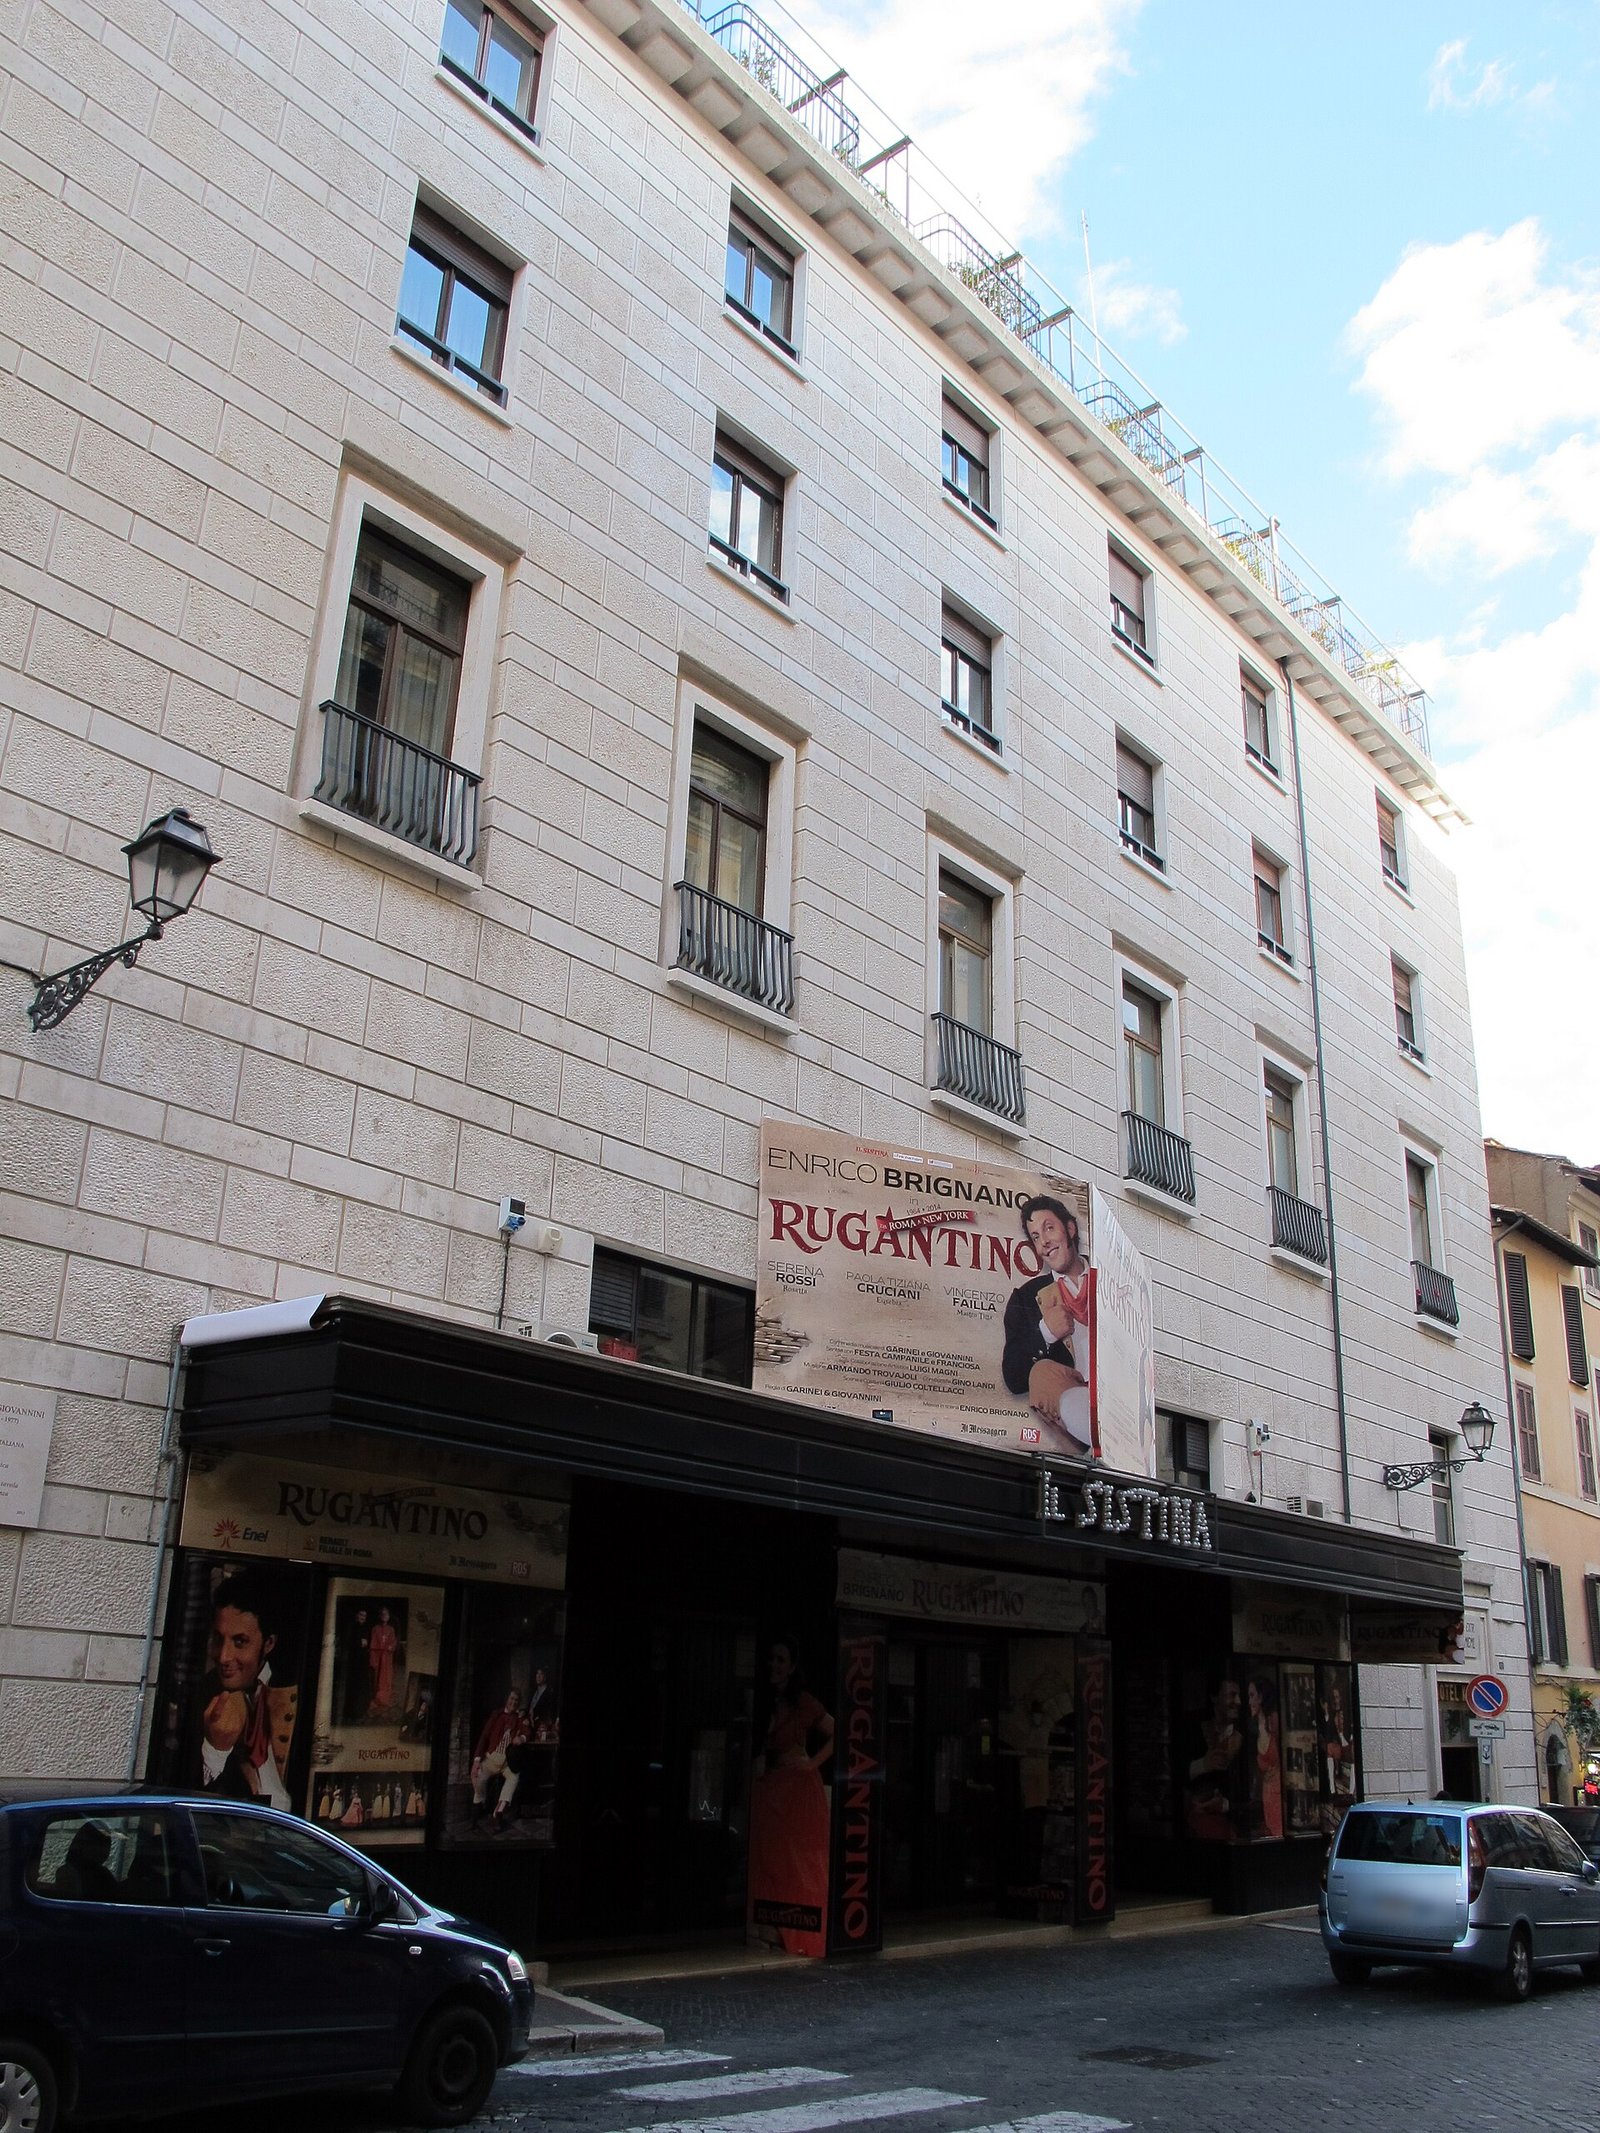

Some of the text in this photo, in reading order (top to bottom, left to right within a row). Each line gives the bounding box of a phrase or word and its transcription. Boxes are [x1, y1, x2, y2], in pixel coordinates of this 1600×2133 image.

[768, 1147, 1032, 1210] ENRICO BRIGNANO
[926, 1203, 941, 1212] 2014
[889, 1220, 916, 1231] ROMA
[922, 1213, 942, 1225] NEW
[944, 1211, 969, 1221] YORK
[768, 1198, 1043, 1281] RUGANTINO
[767, 1260, 825, 1278] SERENA
[776, 1272, 816, 1287] ROSSI
[846, 1271, 931, 1291] PAOLA TIZIANA
[857, 1282, 920, 1301] CRUCIANI
[943, 1285, 1005, 1304] VINCENZO
[952, 1297, 997, 1312] FAILLA
[854, 1348, 880, 1358] FESTA
[881, 1352, 929, 1365] CAMPANILE
[936, 1359, 980, 1371] FRANCIOSA
[886, 1345, 920, 1356] GARINEI
[926, 1350, 973, 1362] GIOVANNINI
[826, 1363, 871, 1375] ARMANDO
[872, 1368, 917, 1381] TROVAJOLI
[952, 1378, 971, 1387] GINO
[972, 1381, 996, 1391] LANDI
[909, 1365, 959, 1377] LUIGI MAGNI
[786, 1385, 823, 1396] GARINEI
[831, 1390, 882, 1403] GIOVANNINI
[884, 1379, 912, 1390] GIULIO
[913, 1383, 965, 1396] COLTELLACCI
[959, 1404, 988, 1415] ENRICO
[989, 1407, 1030, 1419] BRIGNANO
[969, 1424, 1008, 1437] Messaggero
[1022, 1428, 1037, 1441] RDS
[275, 1480, 488, 1542] RUGANTINO
[1036, 1471, 1212, 1551] IL SISTINA
[242, 1527, 269, 1543] Enel
[512, 1561, 528, 1576] RDS
[842, 1581, 905, 1602] BRIGNANO
[911, 1576, 1024, 1617] RUGANTINO
[1438, 1684, 1460, 1701] OTEL
[358, 1749, 410, 1760] RUGANTINO
[842, 1640, 878, 1940] RUGANTINO
[1083, 1654, 1109, 1912] RUGANTINO
